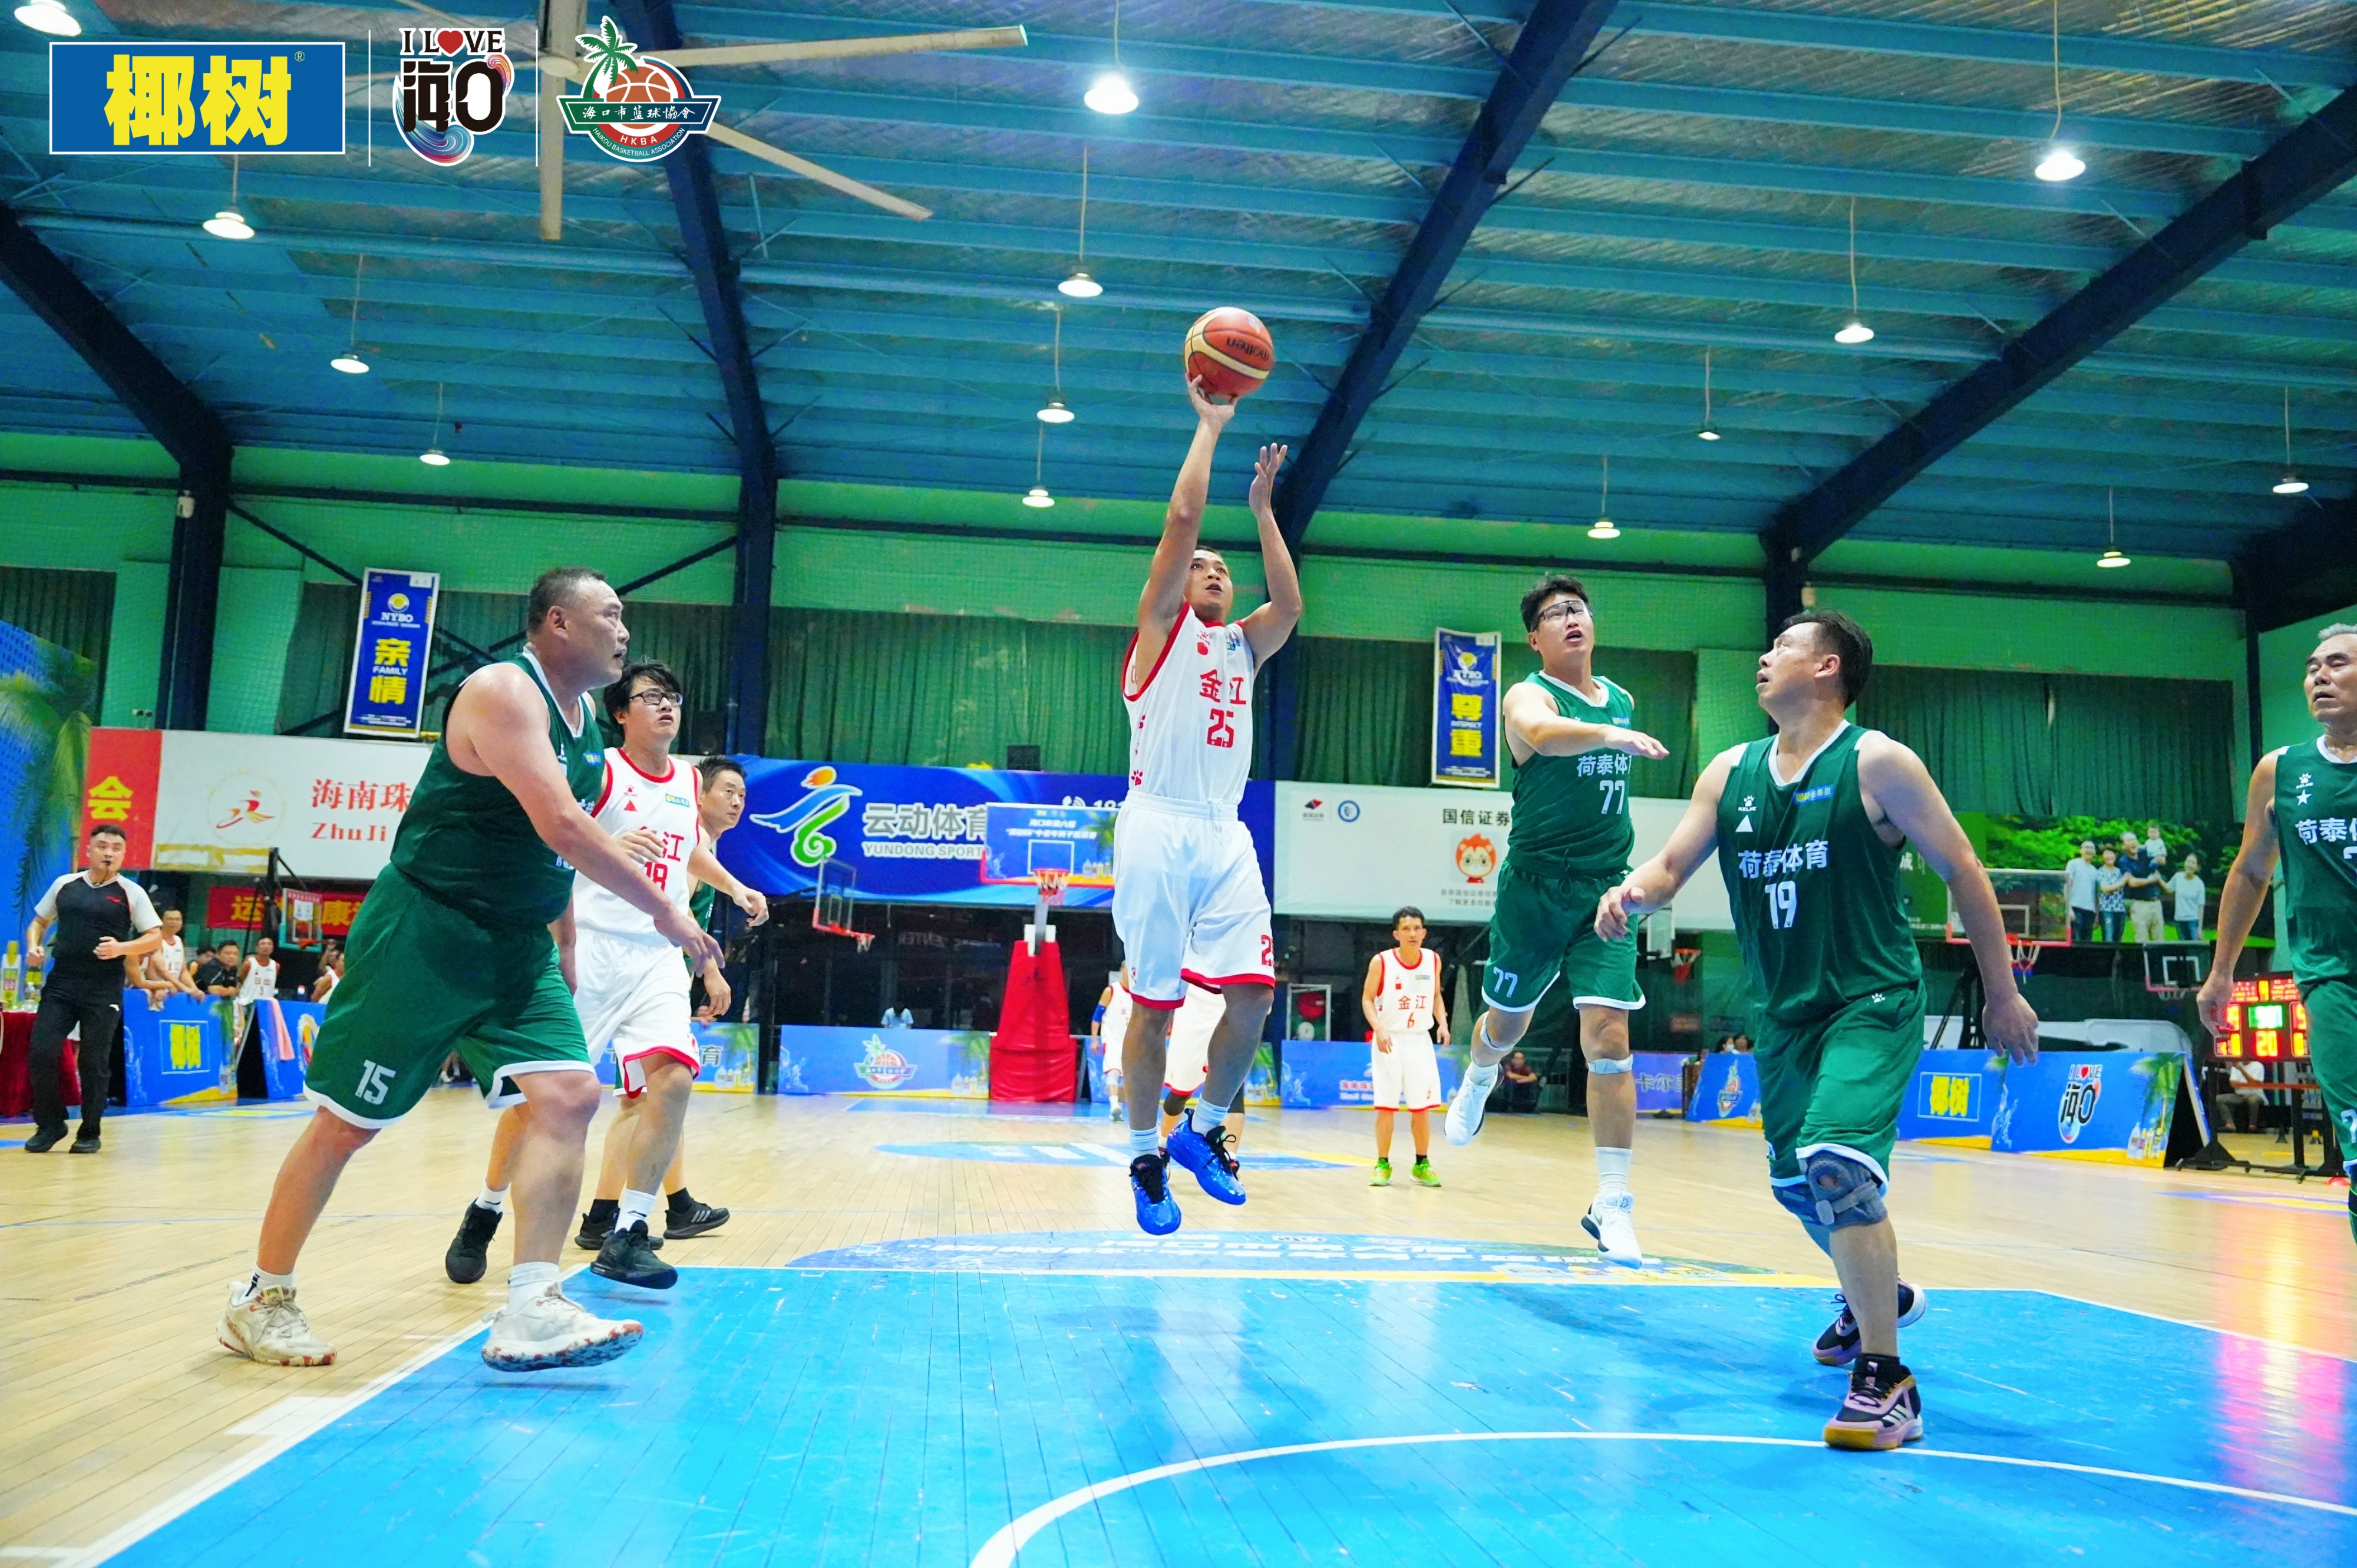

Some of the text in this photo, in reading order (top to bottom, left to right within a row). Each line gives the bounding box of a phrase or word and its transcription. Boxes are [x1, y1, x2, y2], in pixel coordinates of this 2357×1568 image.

[372, 665, 408, 676] FAMILY
[1206, 708, 1234, 748] 25
[1577, 753, 1632, 777] 荷泰体
[88, 775, 133, 821] 会
[1599, 780, 1625, 814] 77
[312, 821, 387, 841] ZhuJi
[863, 804, 986, 839] 云动体育
[1442, 808, 1510, 826] 国信证券
[864, 843, 935, 856] YUNDONG
[1738, 839, 1828, 879] 荷泰体育
[1765, 880, 1797, 929] 19
[1261, 935, 1274, 967] 2
[1493, 966, 1518, 998] 77
[1398, 995, 1427, 1010] 金江
[1407, 1012, 1415, 1028] 6
[2256, 1031, 2278, 1057] 20
[355, 1059, 396, 1105] 15
